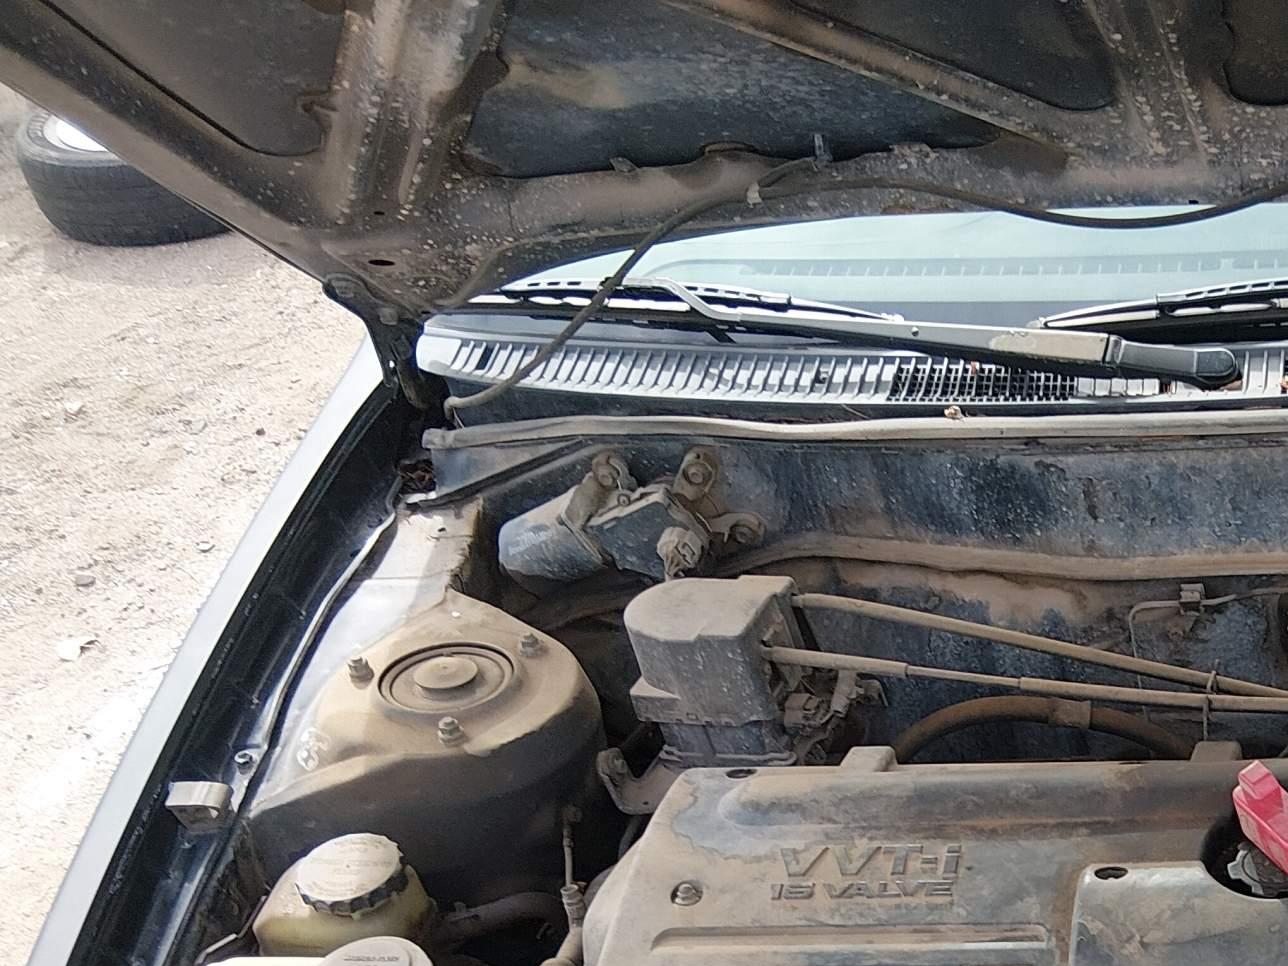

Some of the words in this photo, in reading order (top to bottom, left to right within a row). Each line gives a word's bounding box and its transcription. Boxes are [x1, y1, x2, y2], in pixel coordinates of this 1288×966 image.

[780, 844, 962, 879] VVT-i
[770, 882, 816, 900] 16
[823, 880, 955, 901] VALVE
